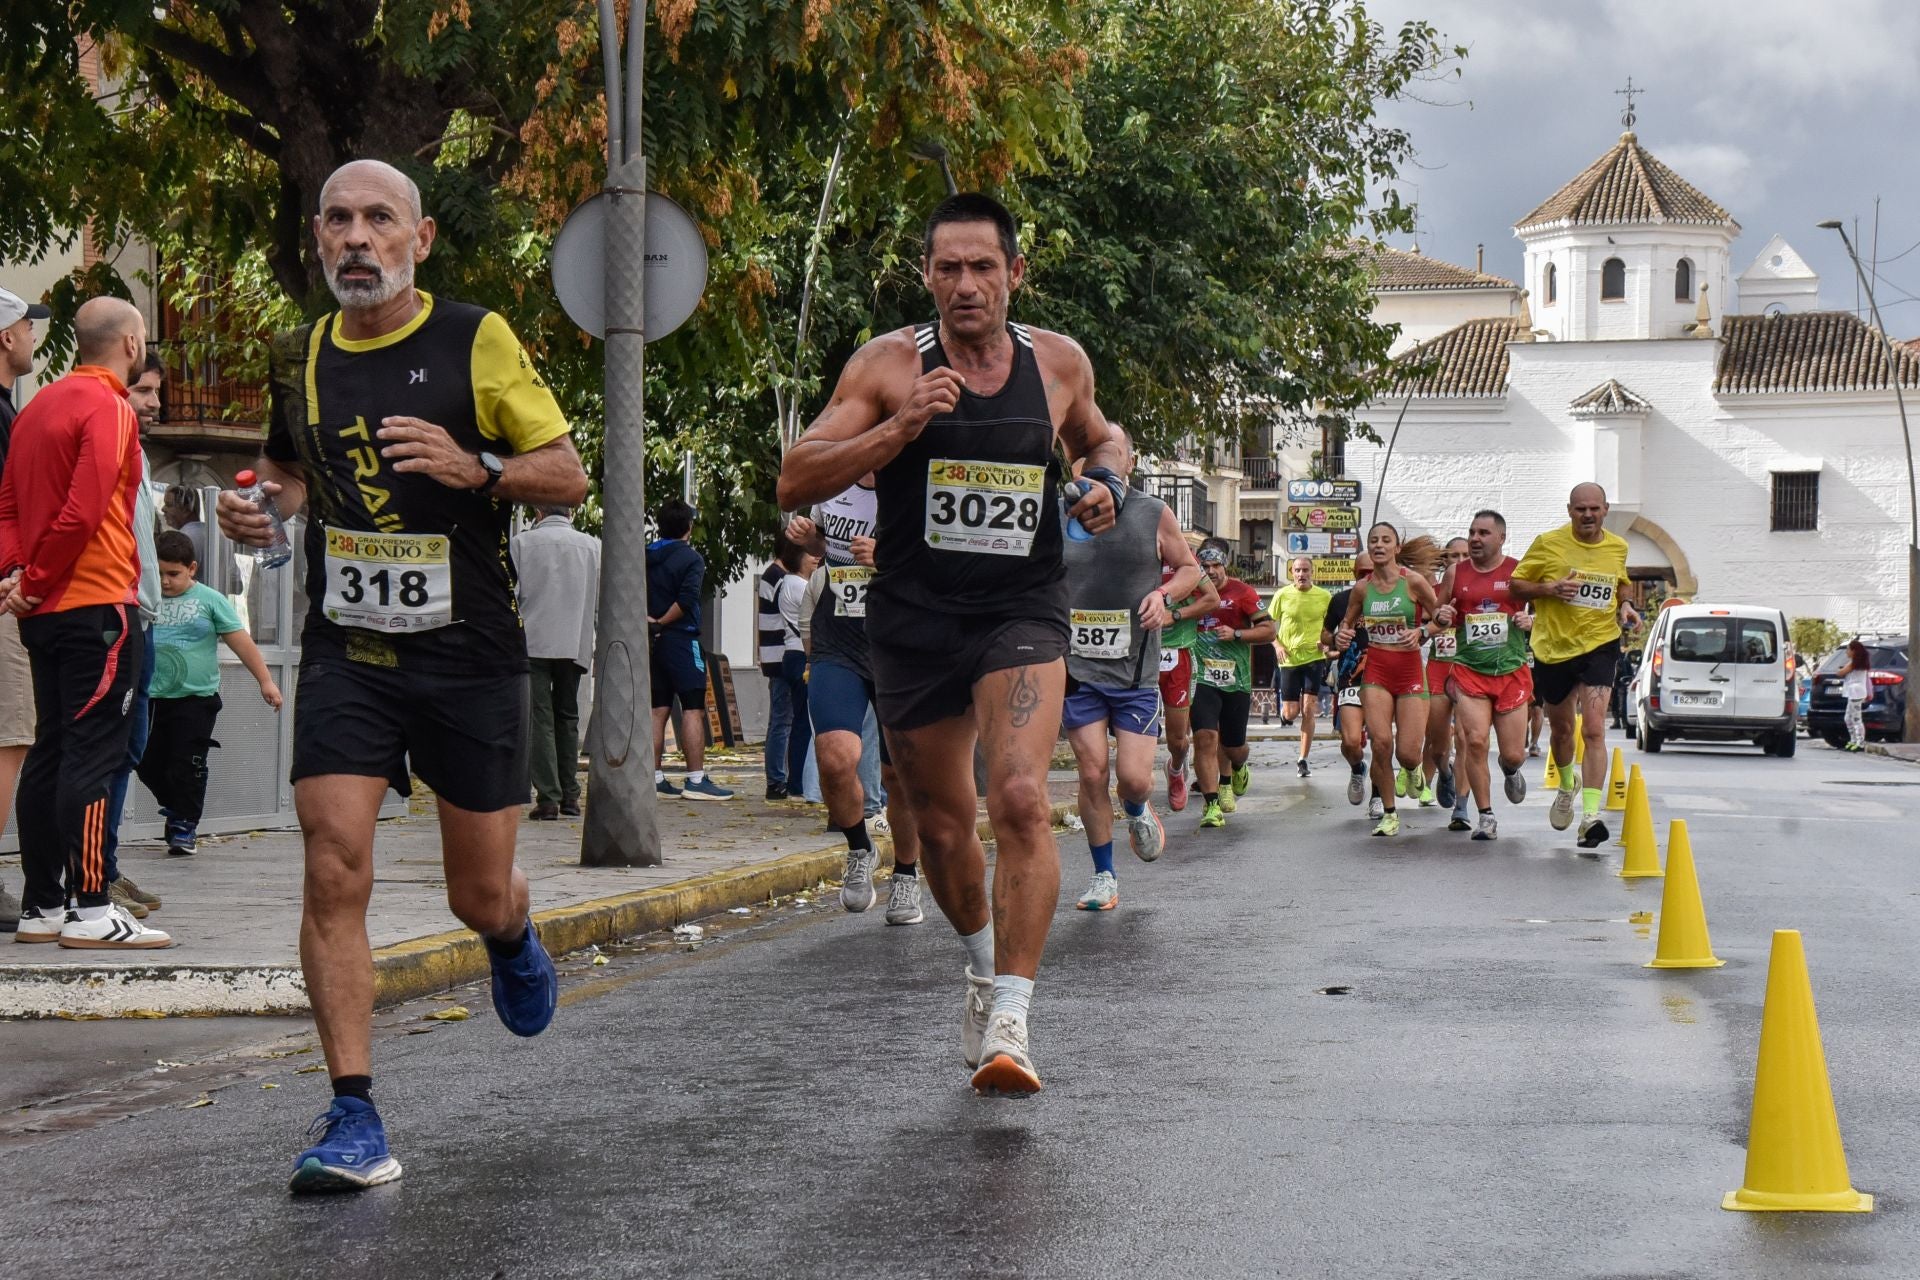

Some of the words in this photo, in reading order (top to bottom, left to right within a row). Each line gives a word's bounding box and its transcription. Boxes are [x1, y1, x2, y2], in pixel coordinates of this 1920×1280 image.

[946, 465, 967, 481] 38
[965, 470, 1025, 486] FONDO
[993, 467, 1021, 475] PREMIO
[930, 490, 1039, 533] 3028
[338, 535, 354, 553] 38
[357, 536, 380, 544] GRAN
[382, 538, 417, 546] PREMIO
[354, 542, 422, 558] FONDO
[340, 565, 429, 608] 318
[1575, 584, 1612, 601] 058
[1076, 627, 1121, 646] 587
[1471, 623, 1501, 637] 236
[1703, 696, 1719, 705] JXB
